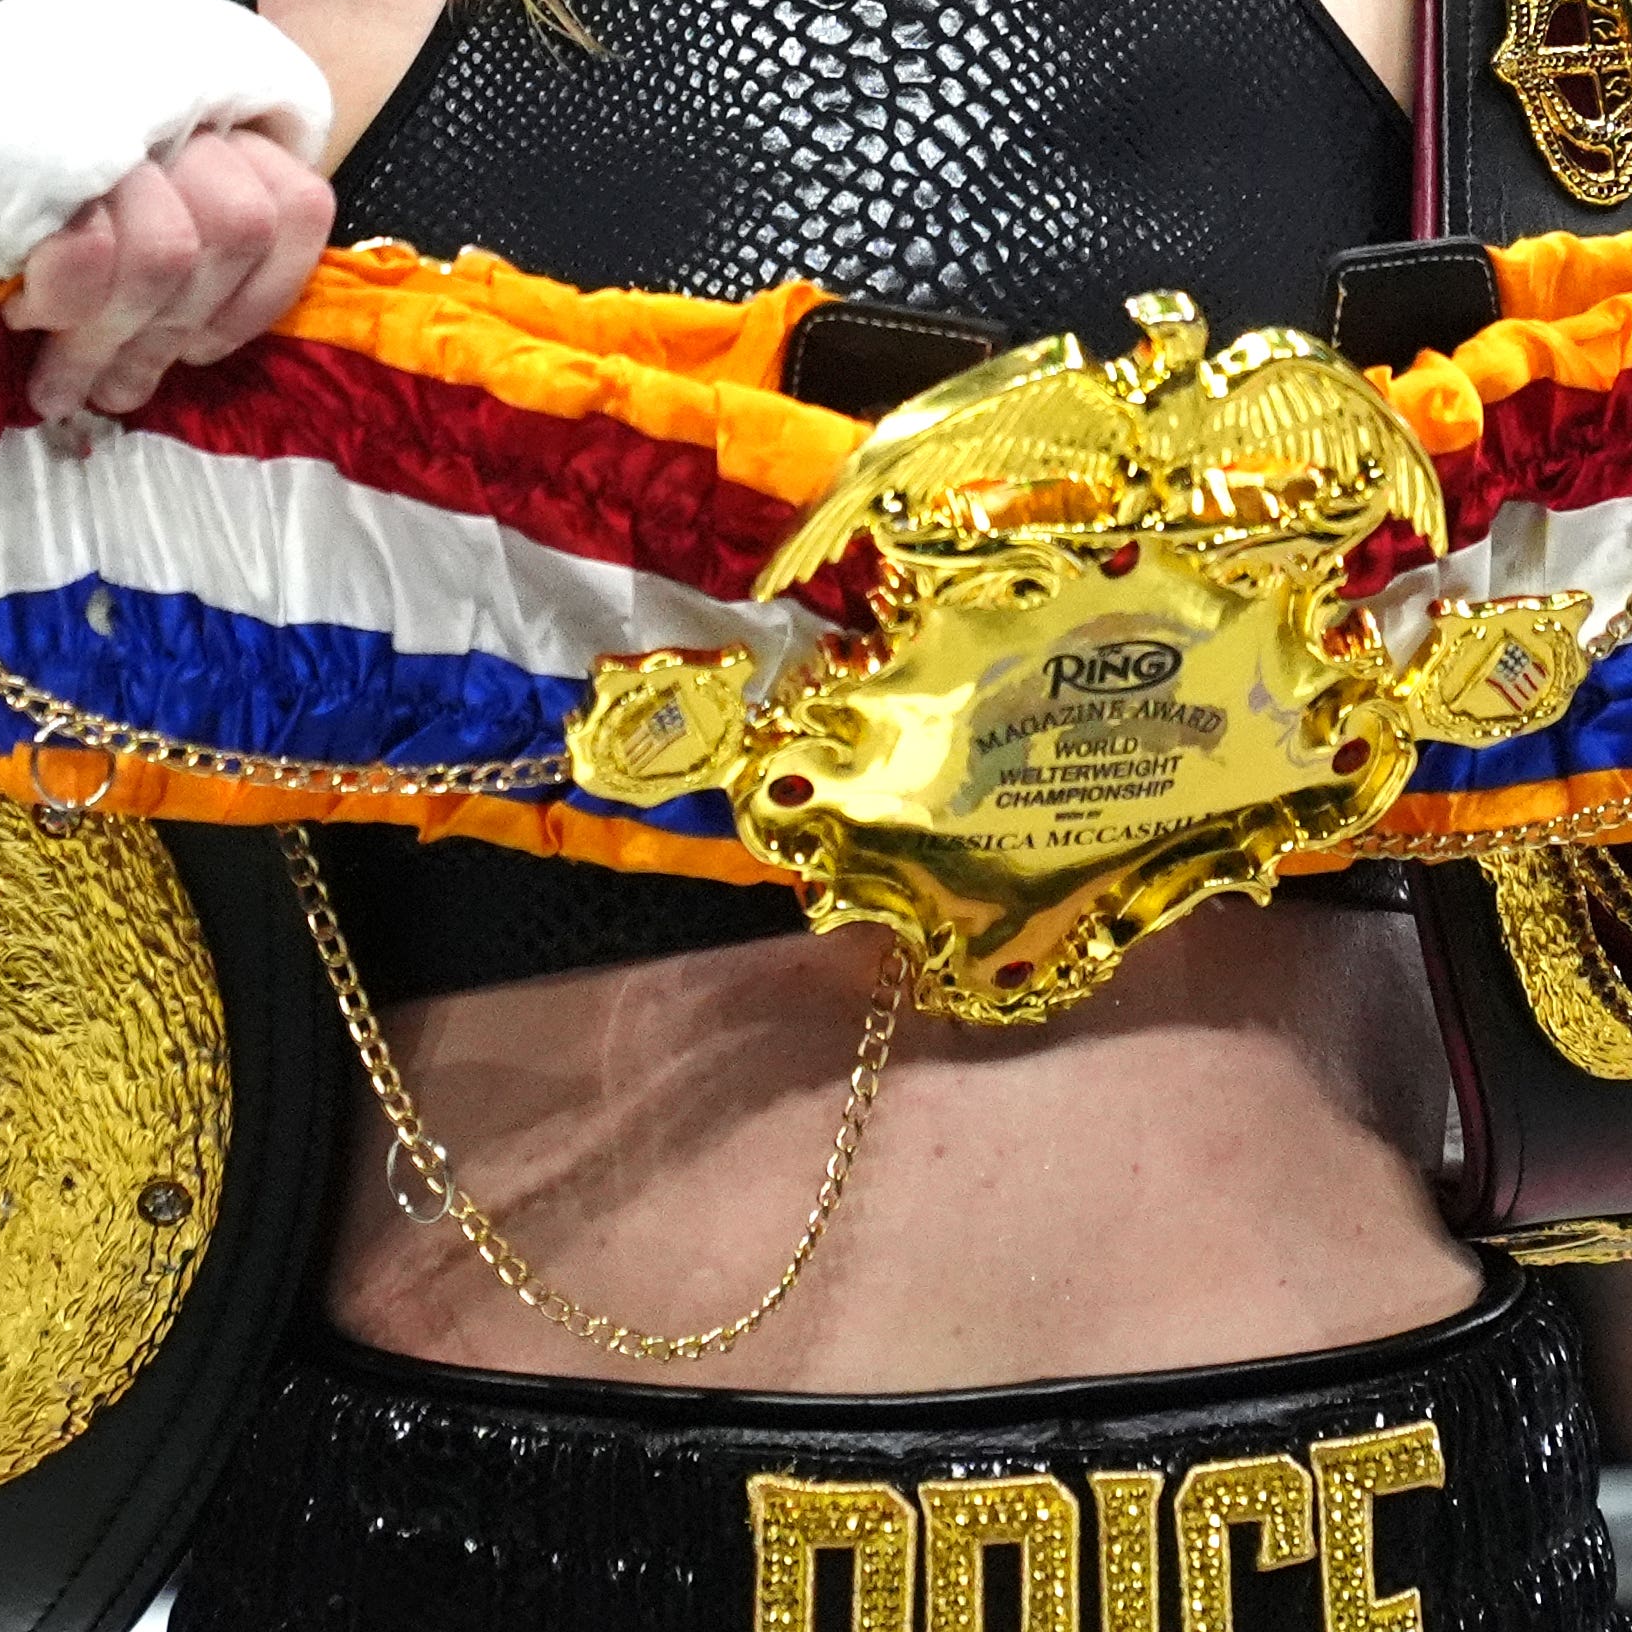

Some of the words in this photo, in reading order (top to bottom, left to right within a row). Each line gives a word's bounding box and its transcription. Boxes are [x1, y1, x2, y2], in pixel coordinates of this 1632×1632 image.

[1043, 649, 1170, 699] RING
[975, 698, 1125, 756] MAGAZINE
[1135, 699, 1222, 735] AWARD
[1054, 737, 1140, 759] WORLD
[999, 755, 1184, 786] WELTERWEIGHT
[994, 779, 1176, 810] CHAMPIONSHIP
